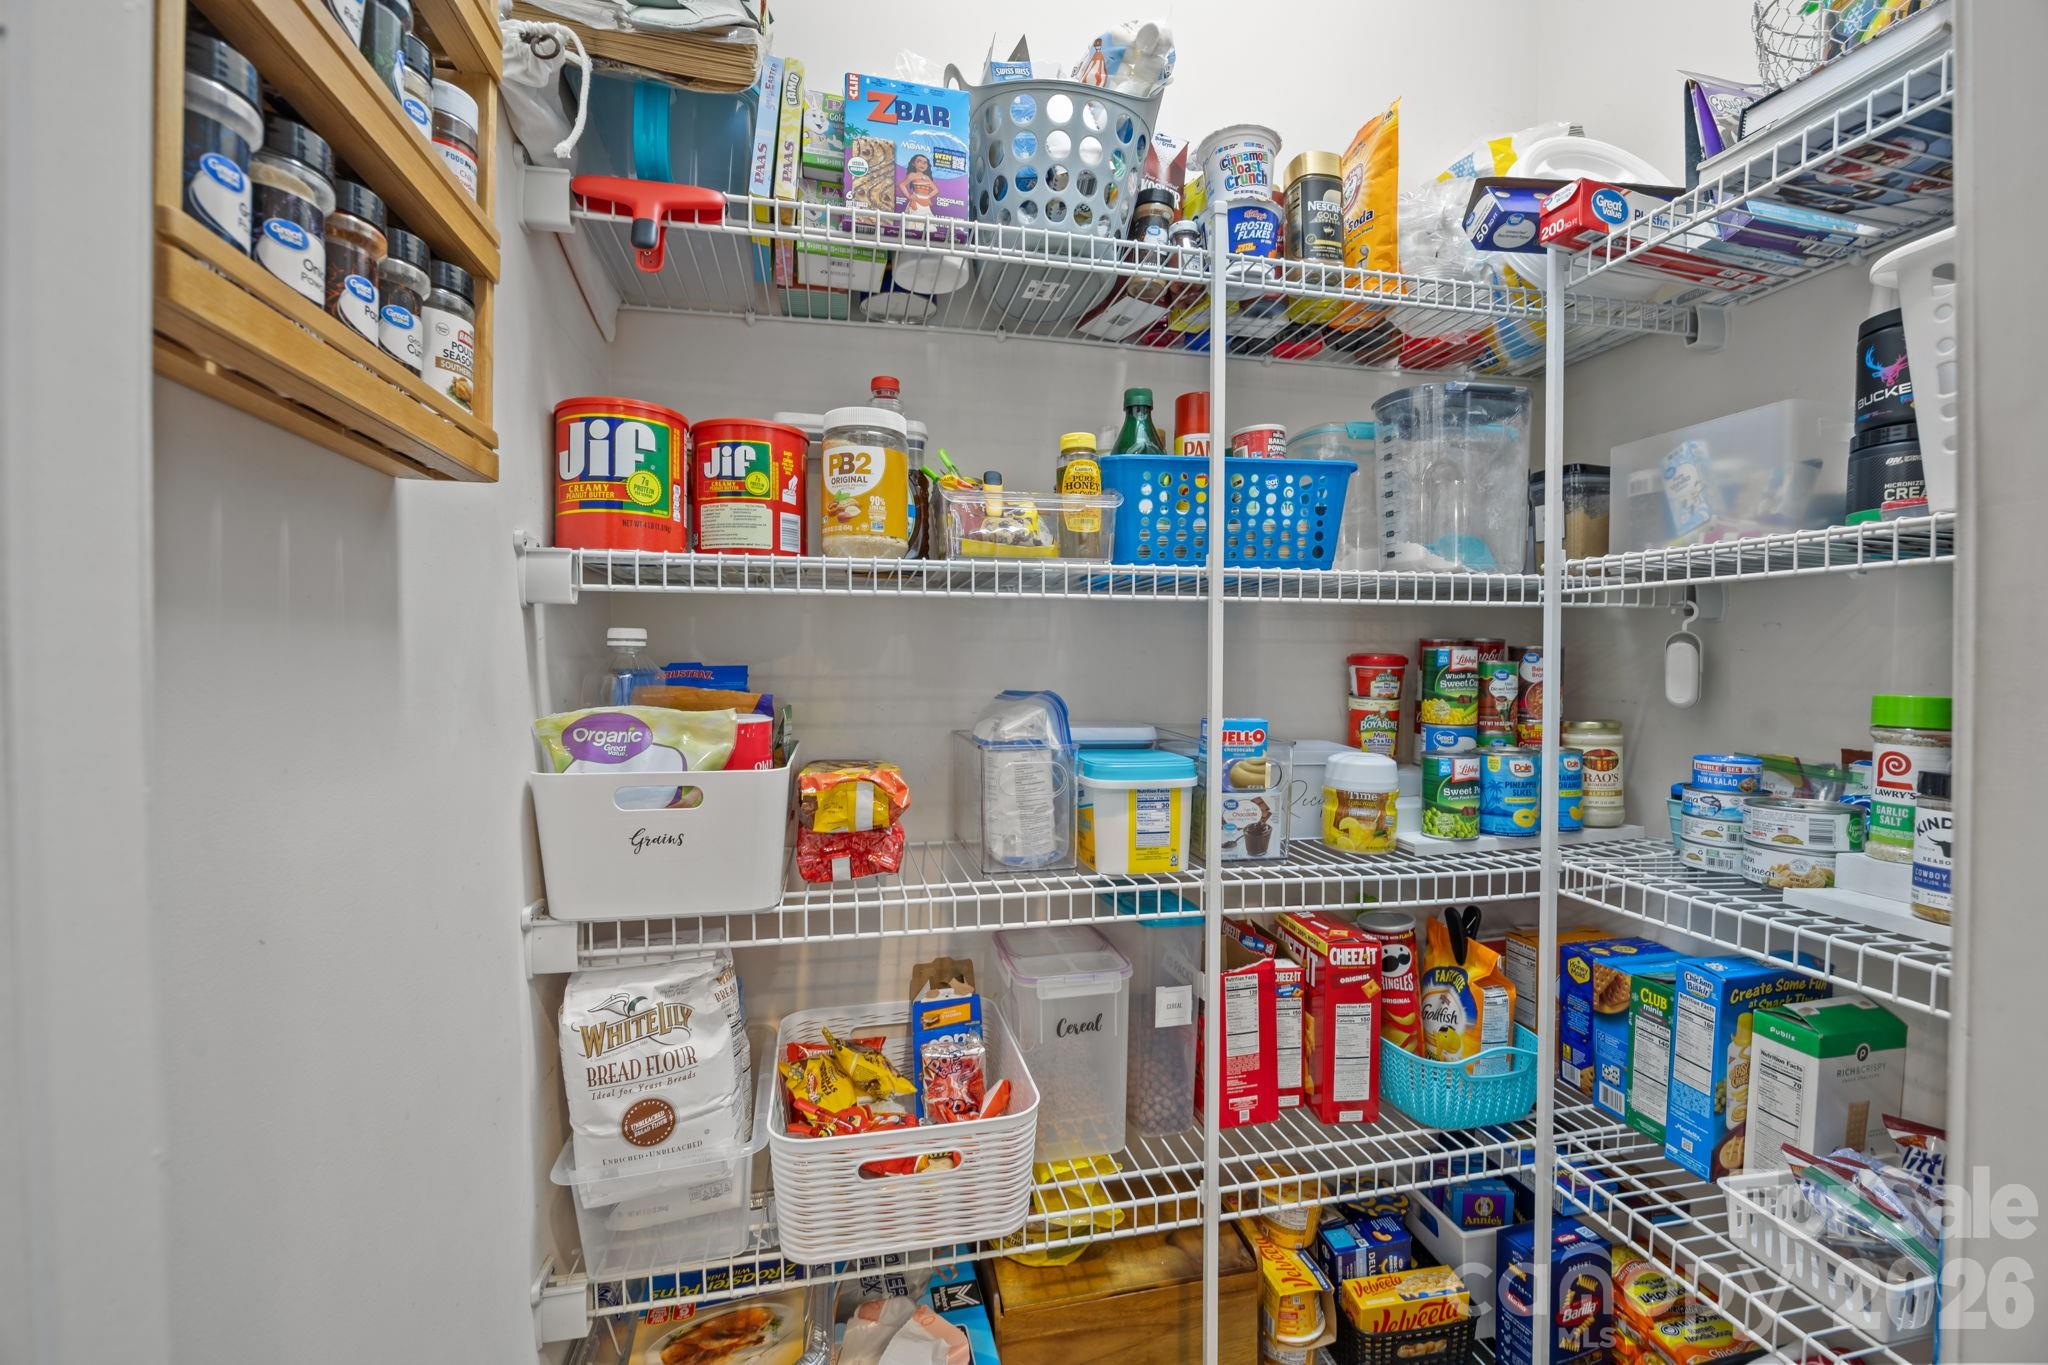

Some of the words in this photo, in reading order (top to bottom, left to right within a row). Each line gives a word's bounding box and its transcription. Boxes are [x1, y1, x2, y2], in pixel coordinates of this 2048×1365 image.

[849, 73, 859, 100] CLIF
[754, 142, 768, 185] PAAS
[781, 140, 795, 184] PAAS
[1595, 195, 1623, 213] Great
[1317, 210, 1339, 221] GOLD
[1602, 206, 1625, 220] Value
[1234, 220, 1274, 233] FROSTED
[1476, 222, 1491, 243] 50
[1541, 218, 1565, 241] 200
[1237, 229, 1273, 241] FLAKES
[559, 419, 657, 480] Jif
[703, 445, 757, 479] Jif
[828, 452, 872, 476] PB2
[831, 475, 868, 484] ORIGINAL
[1064, 481, 1100, 491] HONEY
[567, 483, 610, 493] CREAMY
[633, 484, 655, 494] PROTEIN
[566, 491, 588, 500] PEANUT
[588, 491, 615, 500] BUTTER
[1445, 672, 1466, 680] Whole
[1440, 680, 1468, 688] Sweet
[572, 726, 643, 746] Organic
[1436, 732, 1454, 742] Great
[604, 743, 627, 753] Great
[1514, 763, 1532, 773] Dole
[1583, 773, 1619, 783] RAO'S
[1697, 775, 1712, 784] TUNA
[1713, 777, 1738, 787] SALAD
[1443, 787, 1473, 796] Sweet
[1512, 789, 1532, 797] SLICES
[1875, 788, 1917, 800] LAWRY'S
[1876, 805, 1909, 818] GARLIC
[1879, 814, 1903, 827] SALT
[628, 827, 687, 855] Grains
[1914, 868, 1948, 880] COWBOY
[1569, 959, 1588, 975] Honey
[1570, 967, 1586, 979] Maid
[1339, 973, 1370, 984] ORIGINAL
[1685, 972, 1713, 990] Chicken
[1687, 981, 1709, 996] Biskit
[1730, 983, 1773, 1005] Create
[1776, 977, 1807, 992] Some
[1808, 977, 1828, 990] Fun
[1382, 997, 1411, 1005] ORIGINAL
[1640, 987, 1668, 1010] CLUB
[1642, 1003, 1663, 1017] minis
[579, 1008, 659, 1059] WHITE
[656, 1001, 693, 1036] LILY
[1056, 1013, 1103, 1038] Cereal
[586, 1058, 641, 1088] BREAD
[646, 1045, 698, 1076] FLOUR
[1760, 1049, 1786, 1066] Nutrition
[1786, 1060, 1803, 1072] Facts
[591, 1088, 615, 1101] Ideal
[616, 1086, 633, 1099] for
[638, 1080, 663, 1093] Yeast
[667, 1070, 696, 1086] Breads
[1792, 1081, 1802, 1090] 70
[602, 1152, 645, 1167] ENRICHED
[649, 1139, 703, 1158] UNBLEACHED
[1464, 1215, 1502, 1226] Annie's
[1352, 1275, 1403, 1298] Velveeta
[1373, 1298, 1460, 1333] Velveeta
[1563, 1300, 1597, 1323] Barilla
